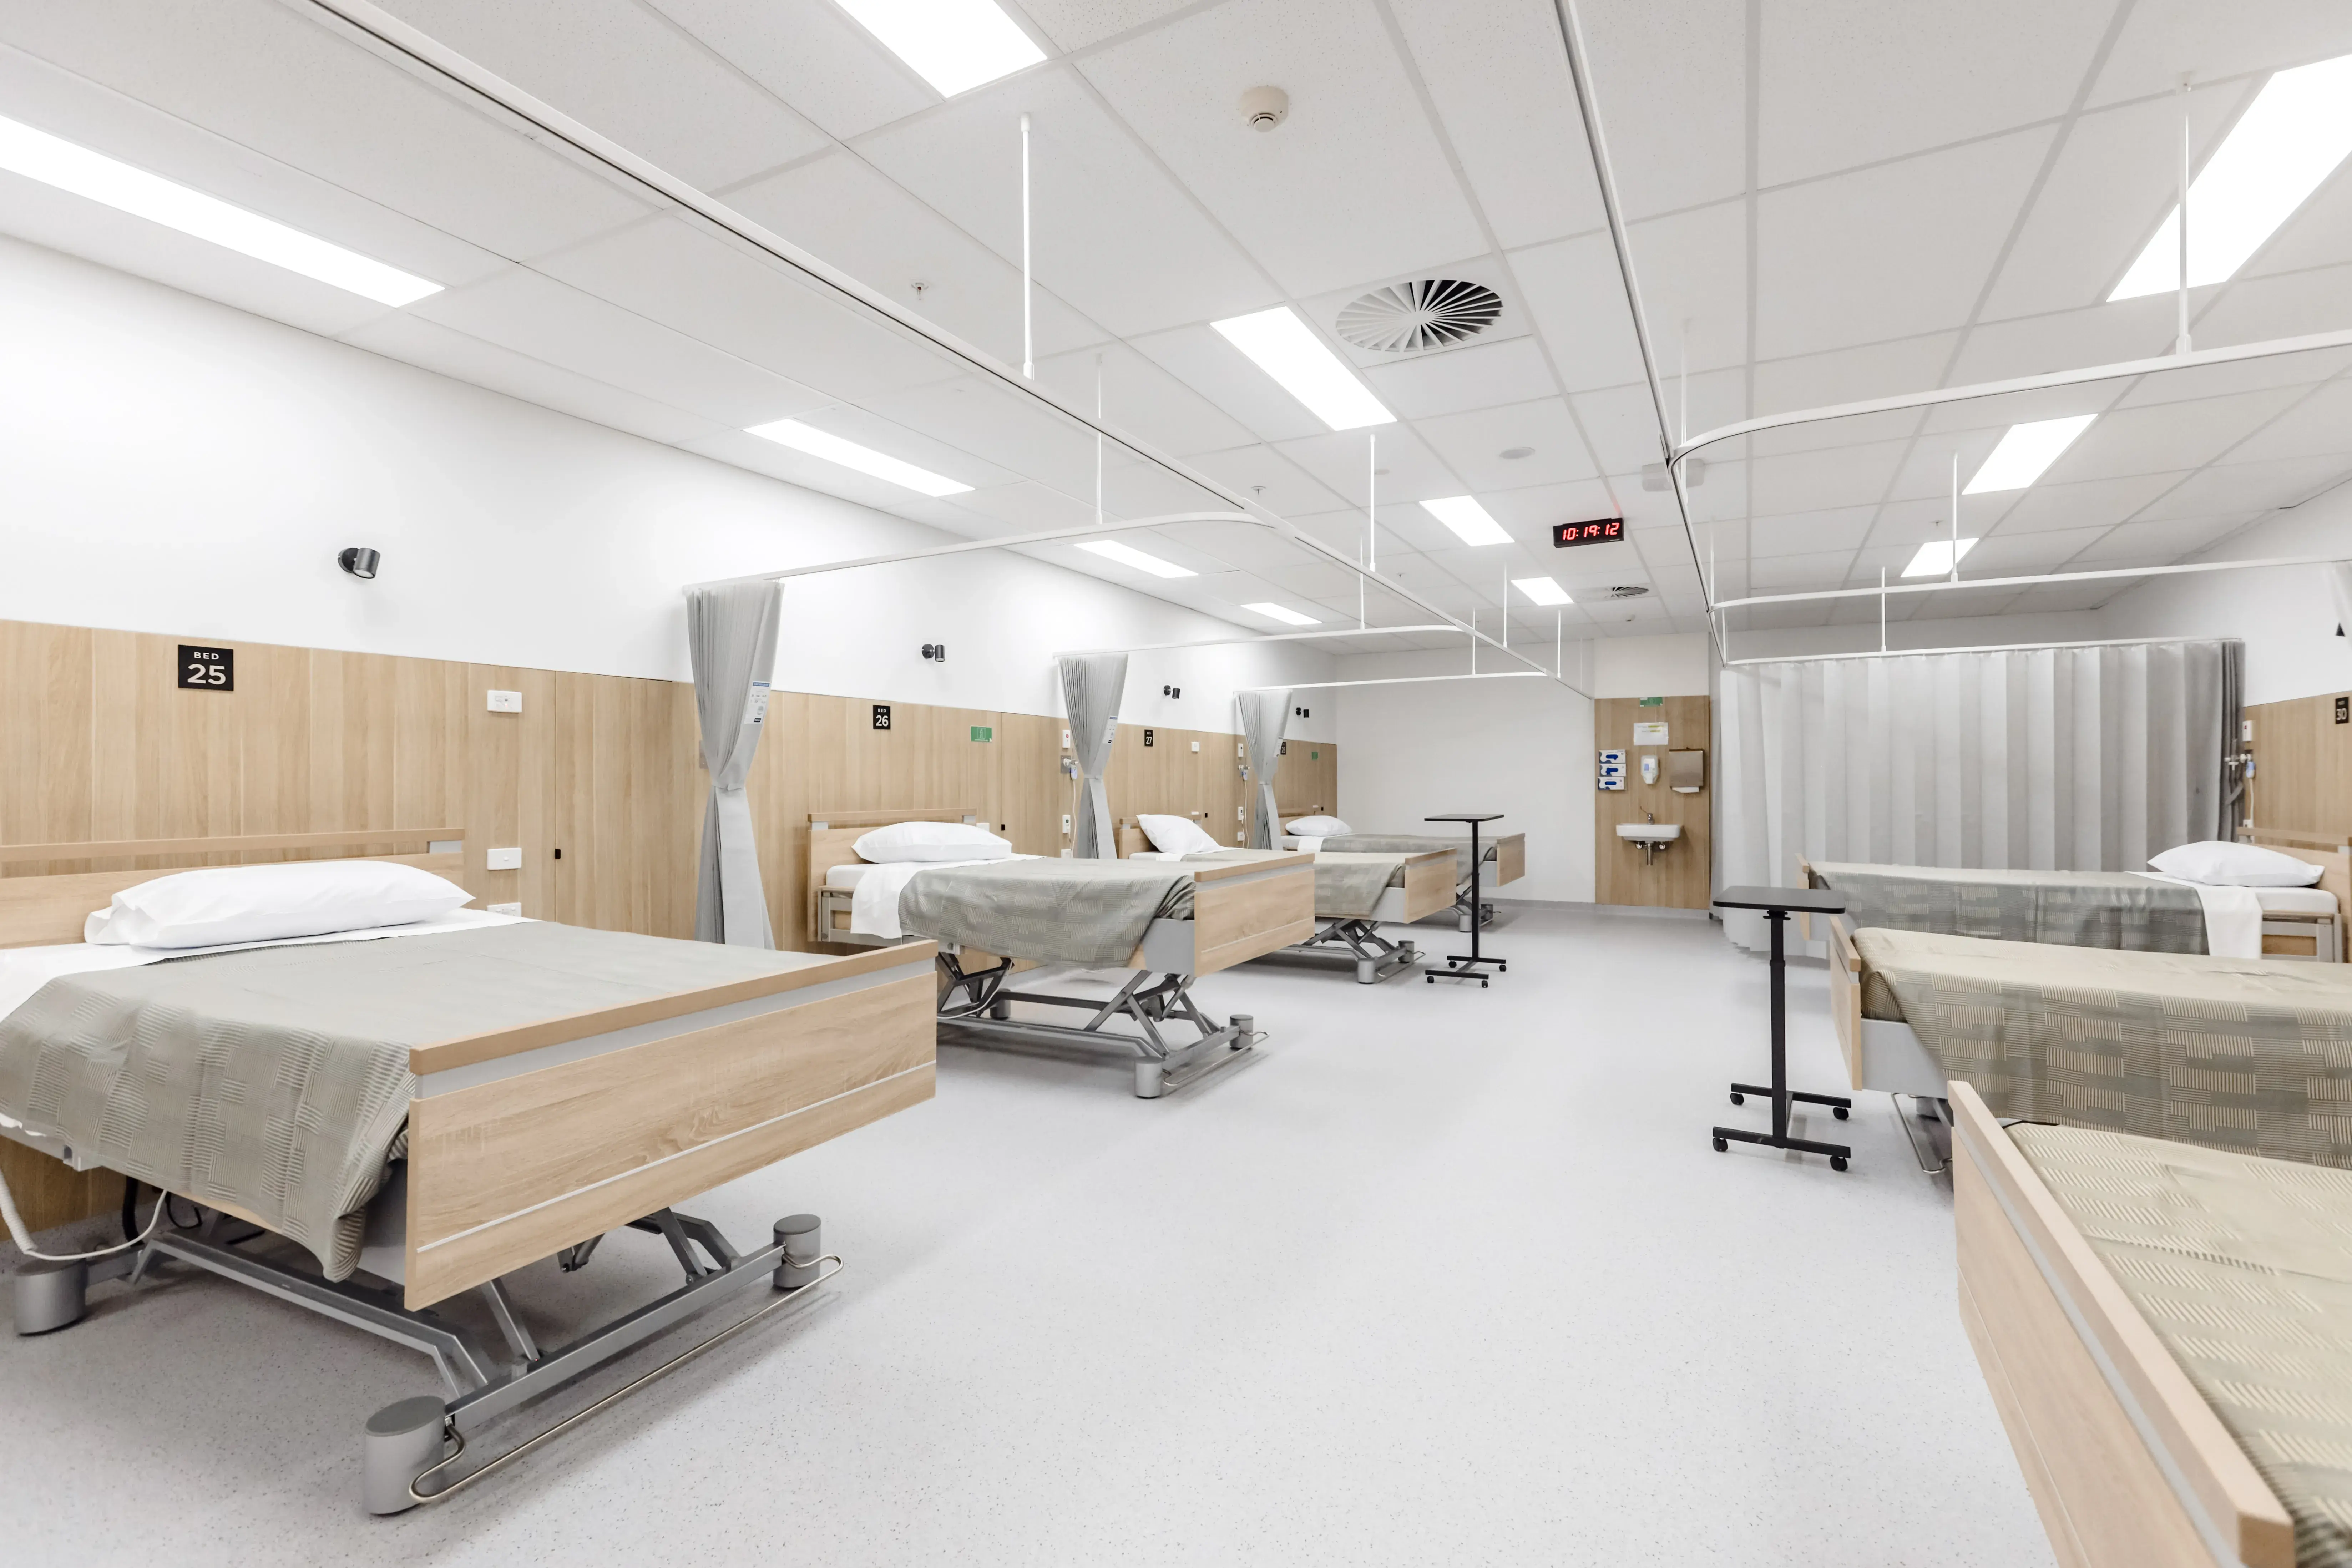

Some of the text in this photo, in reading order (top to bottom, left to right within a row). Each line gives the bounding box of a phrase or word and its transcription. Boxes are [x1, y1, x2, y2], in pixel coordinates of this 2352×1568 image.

[1562, 522, 1620, 540] 10:19:12
[194, 652, 219, 660] BED
[187, 664, 226, 685] 25
[2336, 708, 2347, 720] 30
[876, 715, 889, 727] 26
[1146, 736, 1152, 744] 27
